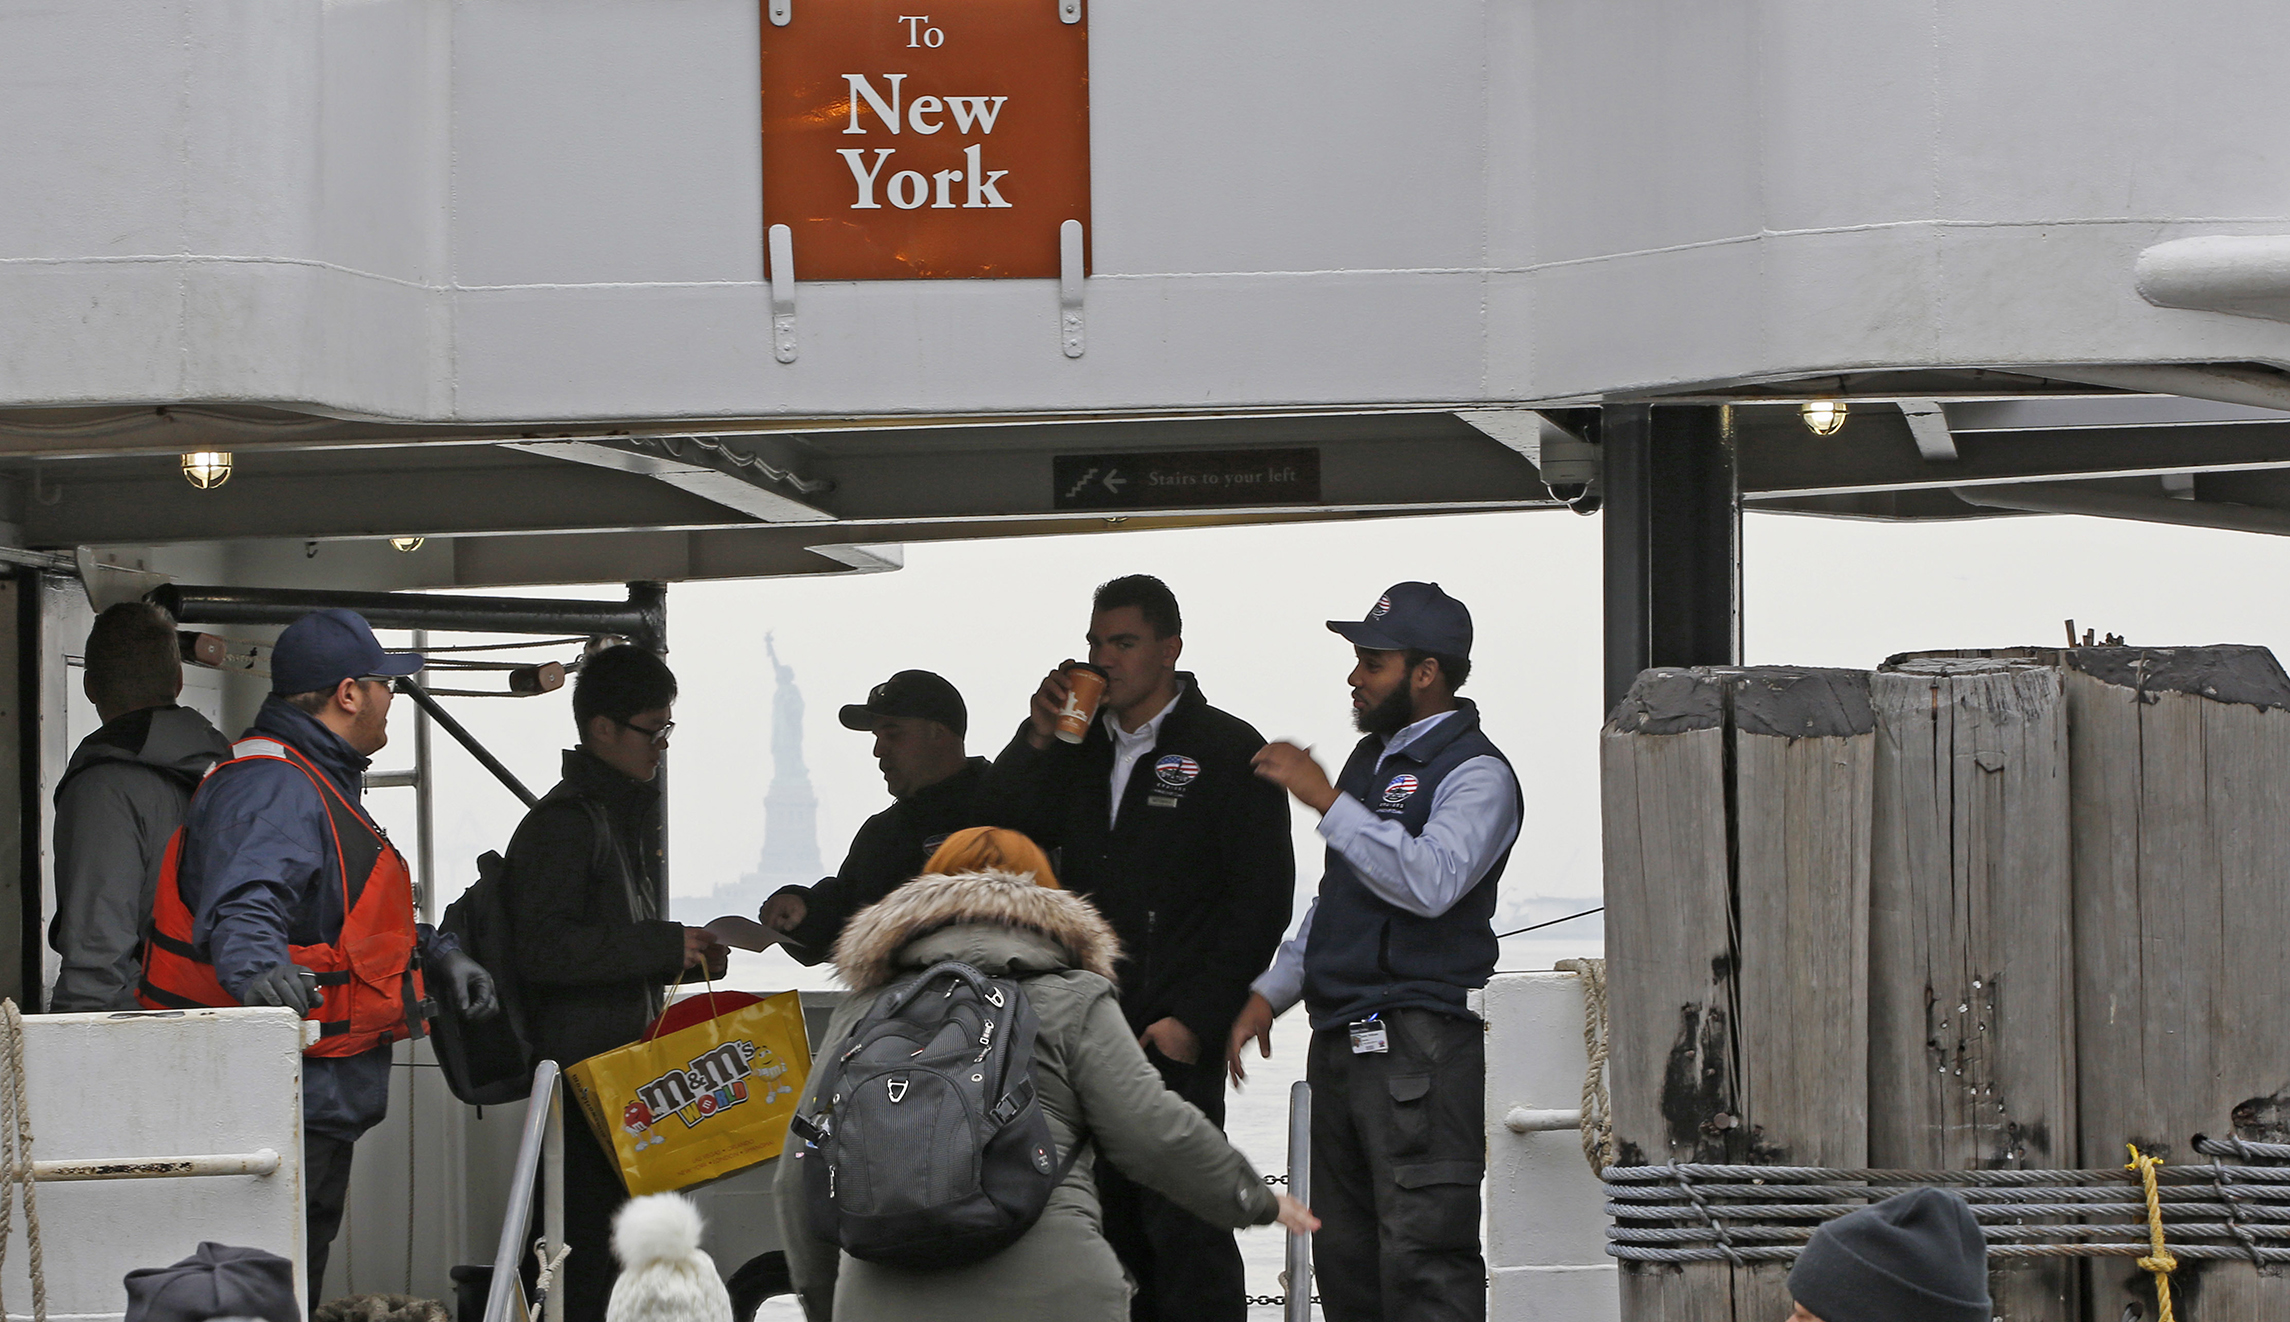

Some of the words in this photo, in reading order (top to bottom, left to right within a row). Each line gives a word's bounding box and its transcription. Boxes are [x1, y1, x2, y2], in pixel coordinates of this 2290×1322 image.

[898, 15, 945, 48] To
[841, 73, 1008, 135] New
[836, 143, 1013, 210] York
[1149, 471, 1196, 486] Stairs
[1203, 472, 1218, 485] to
[1225, 472, 1261, 487] your
[1268, 467, 1296, 482] left
